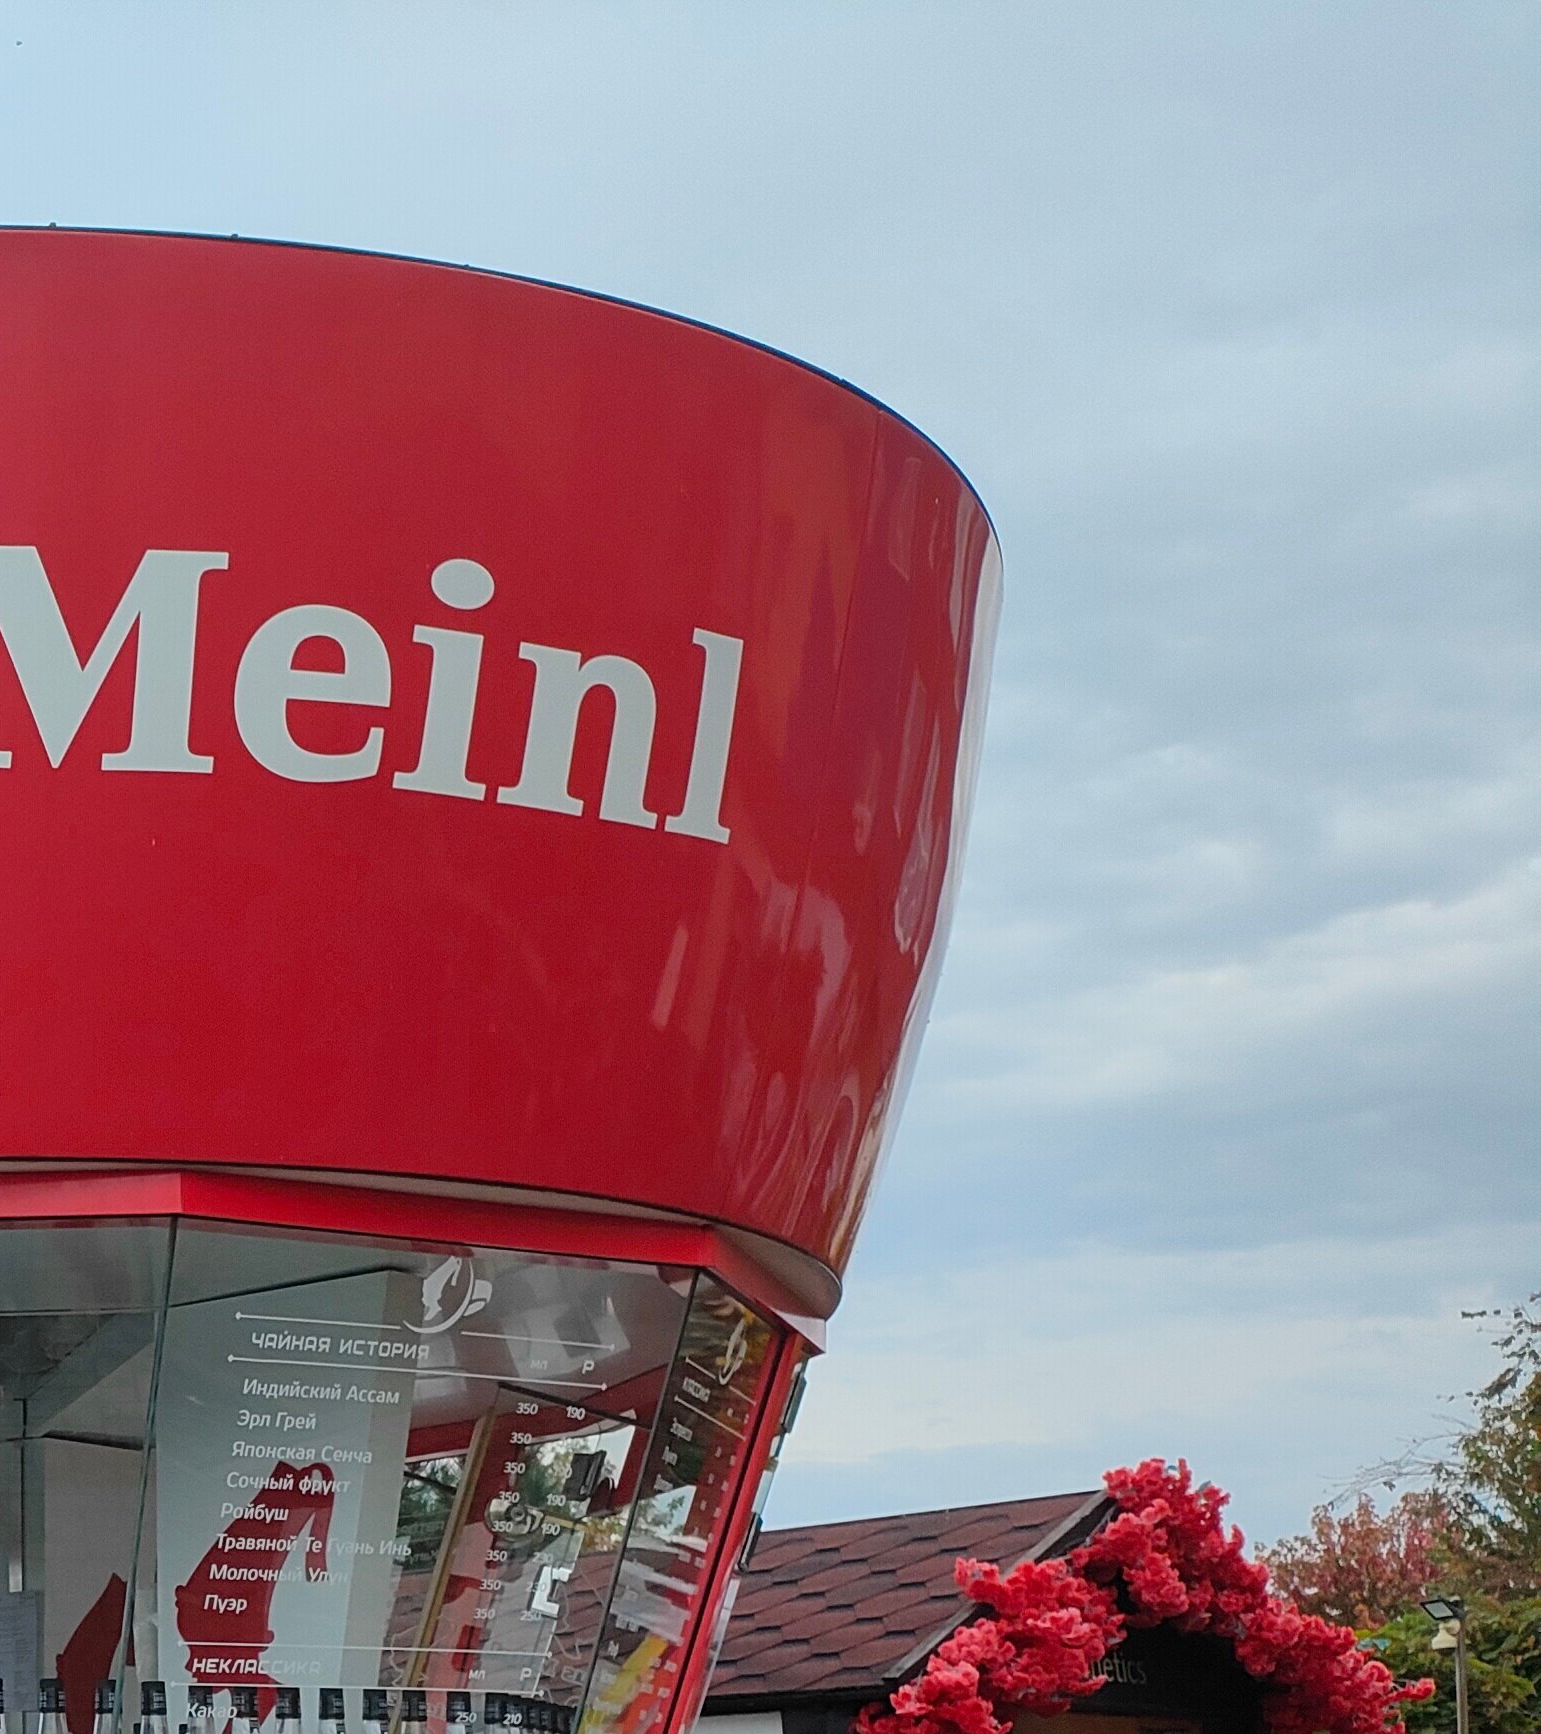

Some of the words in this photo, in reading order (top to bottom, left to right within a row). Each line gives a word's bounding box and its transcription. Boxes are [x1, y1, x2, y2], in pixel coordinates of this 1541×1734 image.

[251, 1330, 331, 1353] ЧАЙНАЯ
[338, 1338, 430, 1360] ИСТОРИЯ
[242, 1378, 341, 1400] Индийский
[346, 1384, 400, 1404] Ассам
[516, 1402, 538, 1415] 350
[566, 1405, 586, 1421] 190
[236, 1409, 271, 1429] Эрл
[275, 1411, 317, 1432] Грей
[509, 1432, 532, 1445] 350
[232, 1440, 316, 1461] Японская
[321, 1445, 373, 1464] Сенча
[503, 1462, 525, 1474] 350
[226, 1471, 294, 1491] Сочный
[298, 1474, 351, 1496] фрукт
[498, 1491, 520, 1504] 350
[546, 1493, 566, 1507] 190
[220, 1502, 289, 1523] Ройбуш
[491, 1520, 513, 1532] 350
[541, 1522, 560, 1536] 190
[216, 1533, 297, 1553] Травяной
[304, 1535, 323, 1553] Те
[328, 1536, 374, 1556] Гуань
[379, 1539, 412, 1557] Инь
[485, 1549, 508, 1562] 350
[209, 1563, 303, 1583] Молочный
[308, 1567, 349, 1585] Улун
[479, 1578, 501, 1591] 350
[203, 1594, 248, 1615] Пуэр
[473, 1608, 495, 1621] 350
[520, 1610, 542, 1623] 250
[192, 1657, 322, 1675] НЕКЛАССИКА
[469, 1668, 486, 1680] мл
[187, 1702, 238, 1719] Какао
[455, 1712, 477, 1723] 250
[502, 1713, 523, 1726] 210
